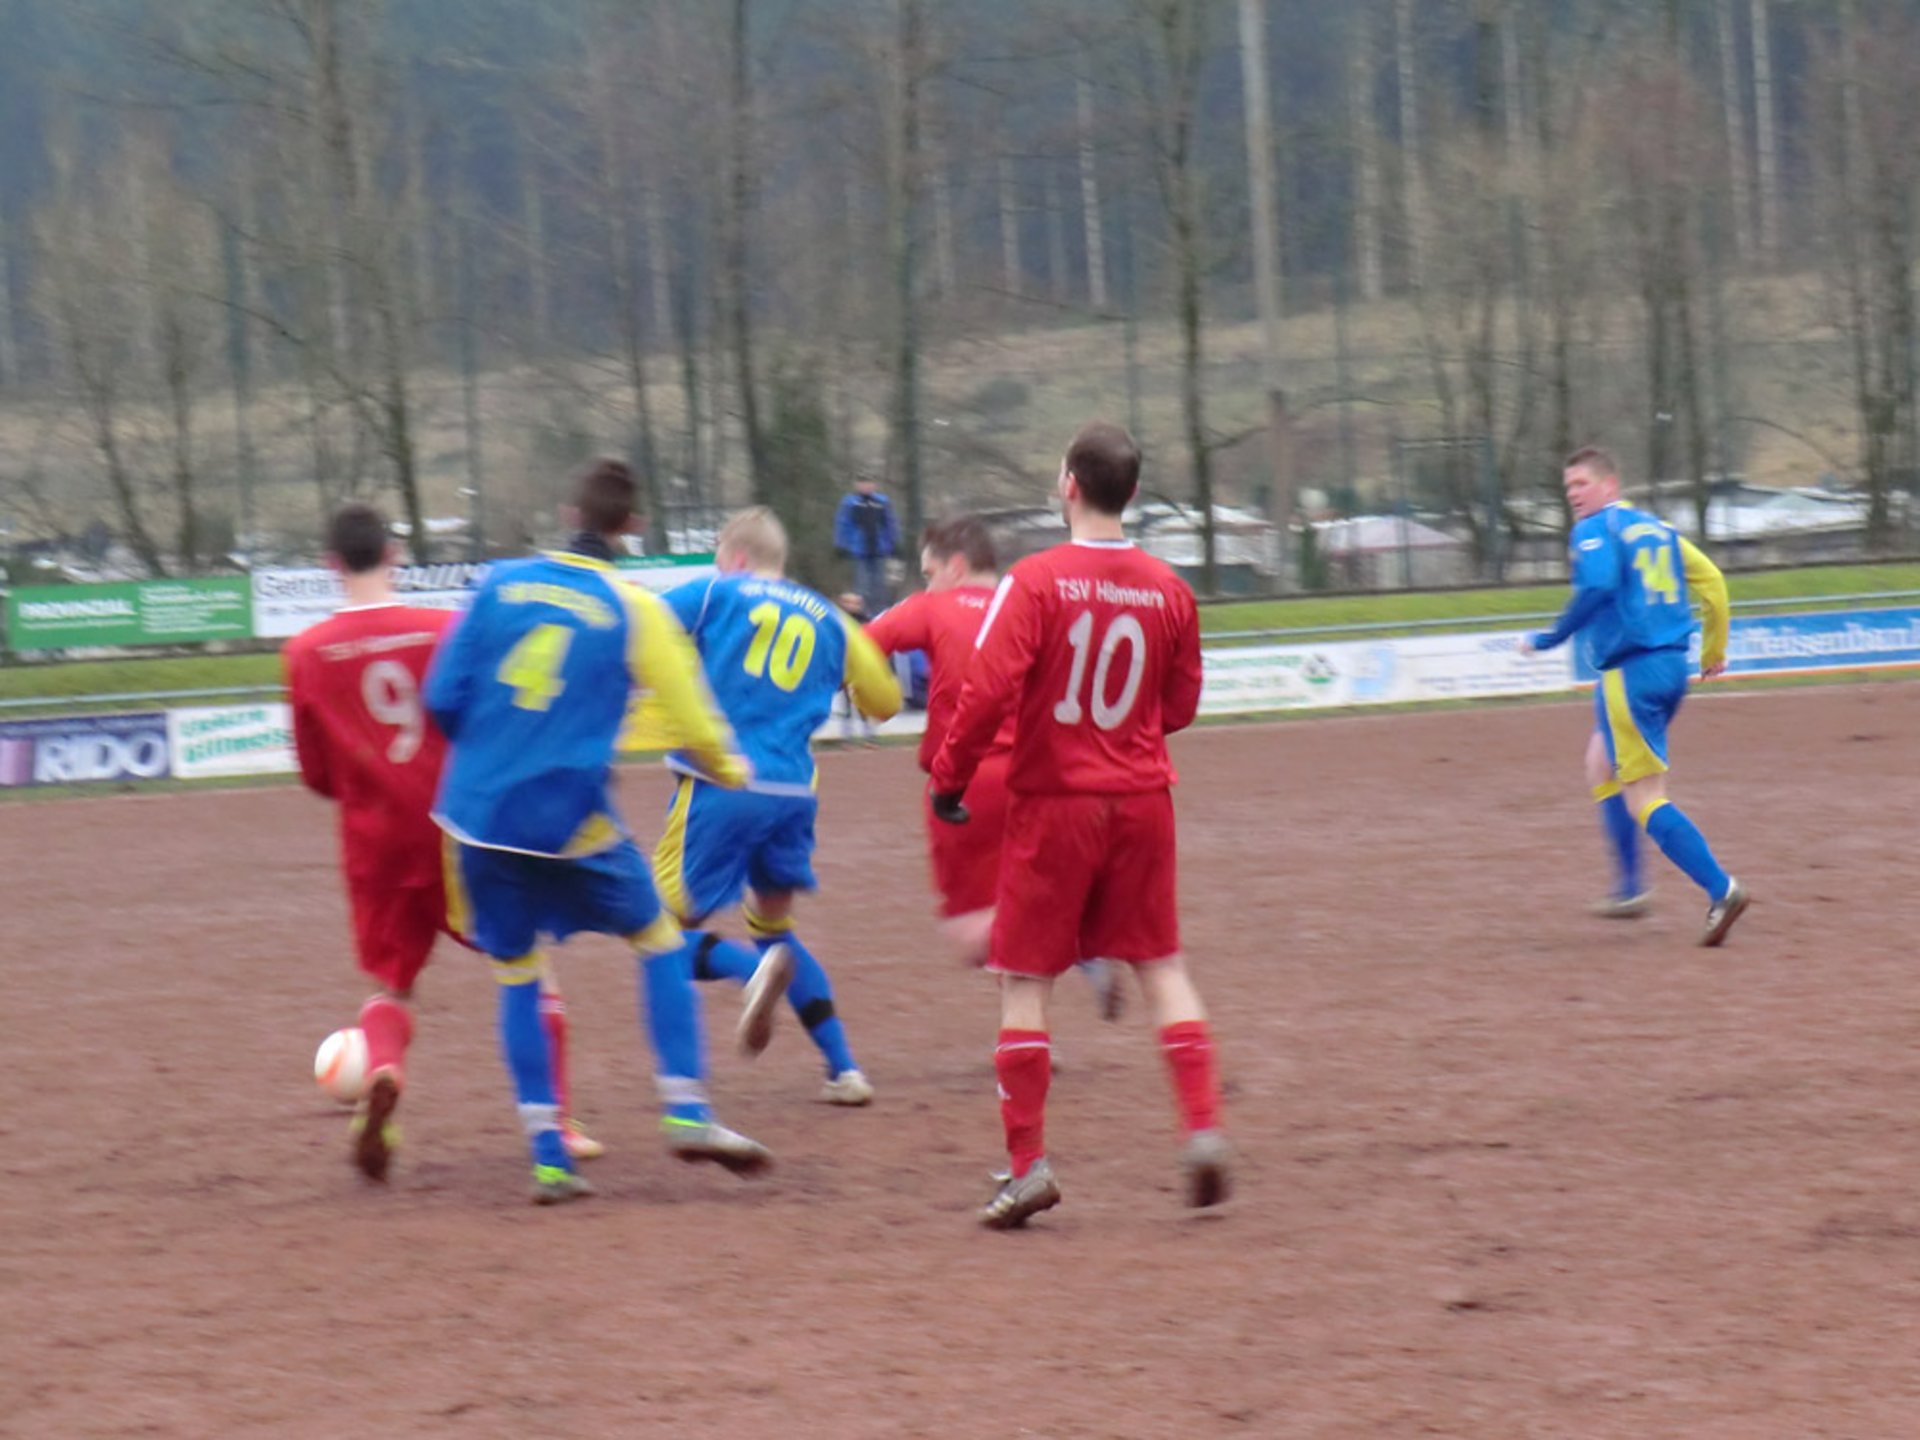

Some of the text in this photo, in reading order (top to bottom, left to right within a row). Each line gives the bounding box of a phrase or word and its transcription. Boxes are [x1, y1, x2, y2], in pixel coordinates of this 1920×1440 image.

[1056, 579, 1091, 602] TSV
[1633, 544, 1678, 604] 14
[496, 622, 575, 712] 4
[742, 601, 816, 692] 10
[1053, 609, 1146, 730] 10
[361, 660, 425, 764] 9
